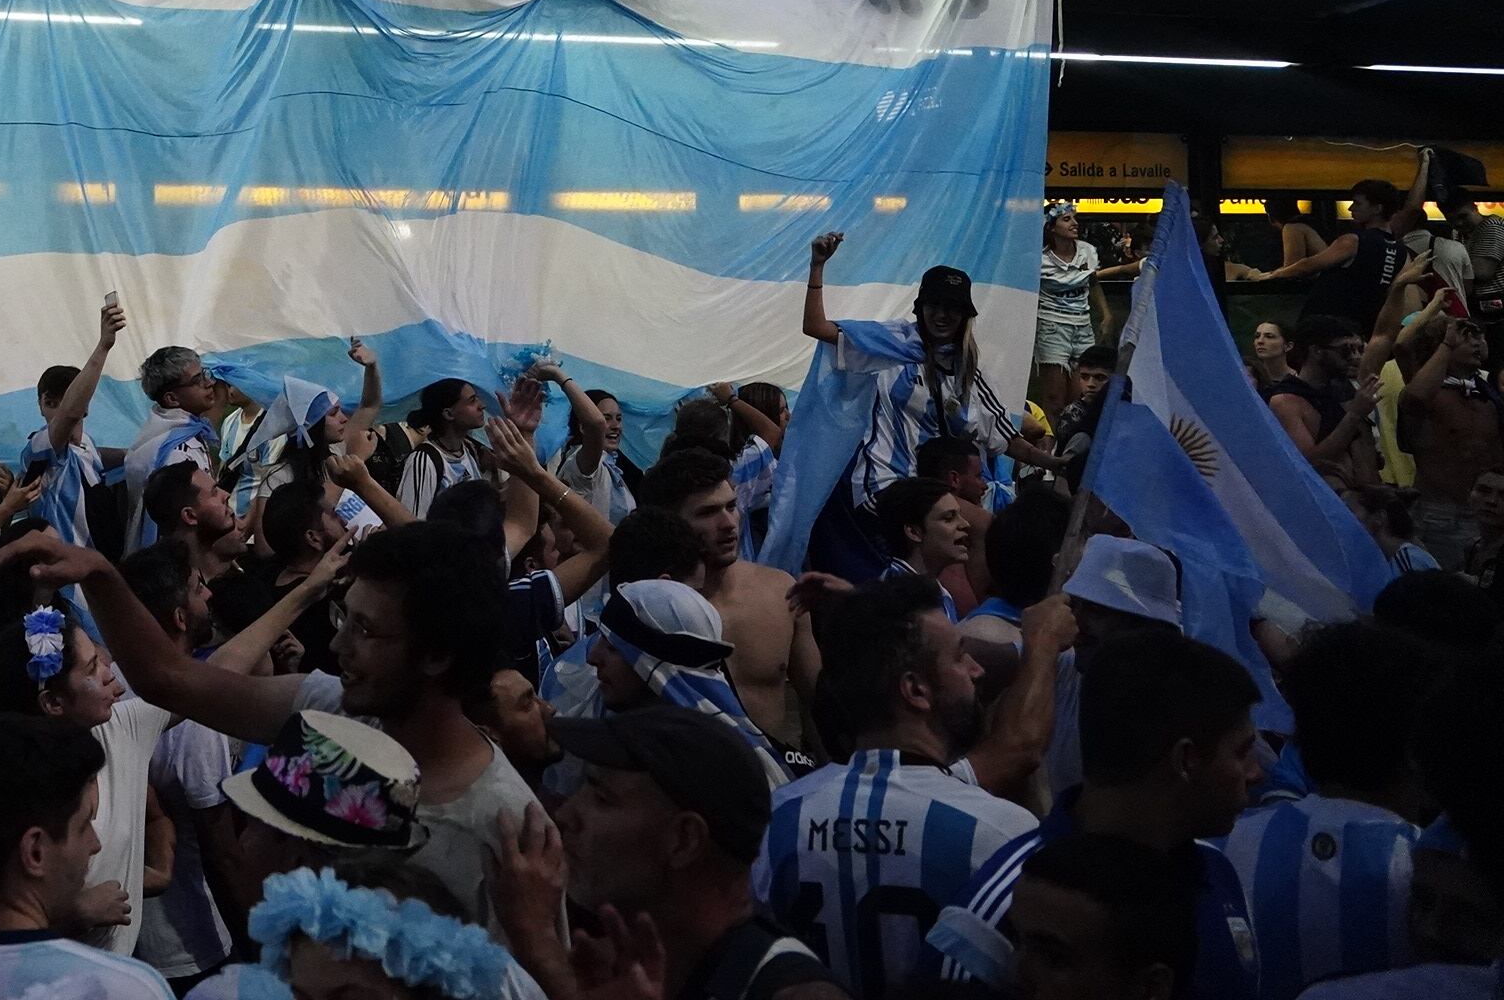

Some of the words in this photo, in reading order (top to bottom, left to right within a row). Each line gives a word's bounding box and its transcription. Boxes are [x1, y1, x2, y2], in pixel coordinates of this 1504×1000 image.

[1060, 161, 1104, 177] Salida
[1109, 166, 1117, 177] a
[1122, 163, 1171, 178] Lavalle
[807, 817, 909, 857] MESSI
